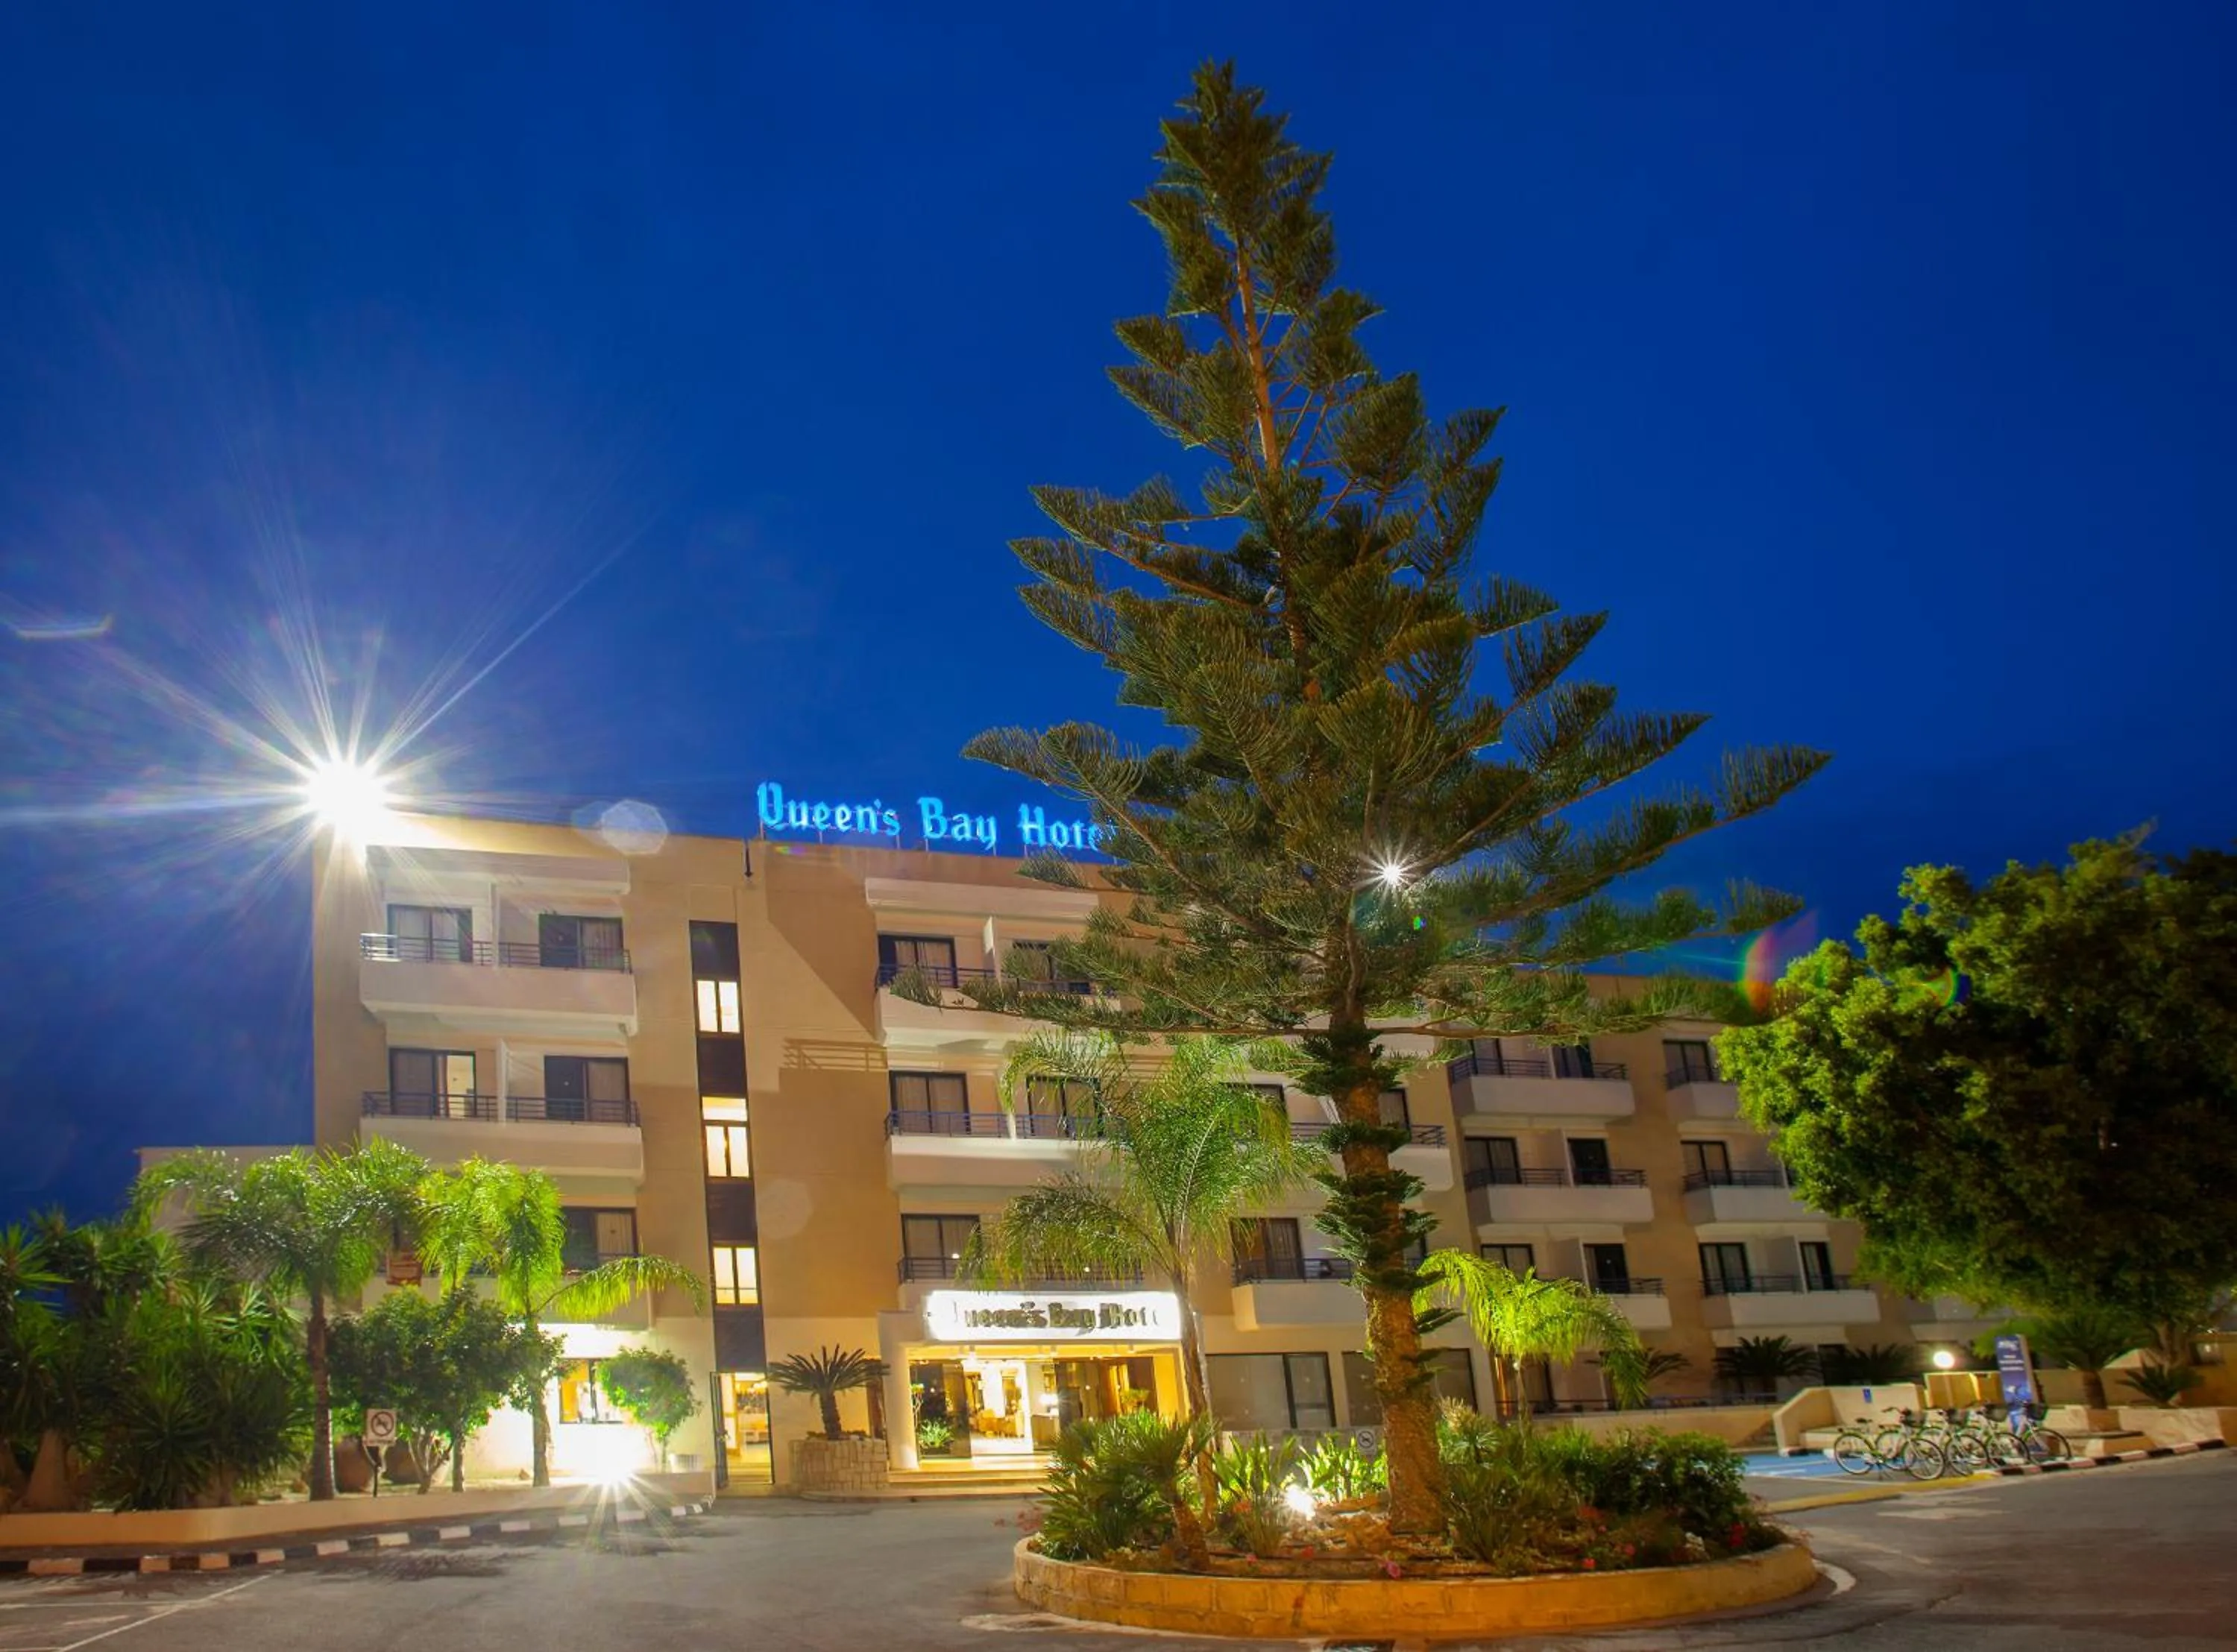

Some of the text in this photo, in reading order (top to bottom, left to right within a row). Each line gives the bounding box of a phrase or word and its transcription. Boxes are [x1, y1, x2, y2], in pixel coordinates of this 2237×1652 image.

[757, 781, 1117, 851] Queen's Bay Hote
